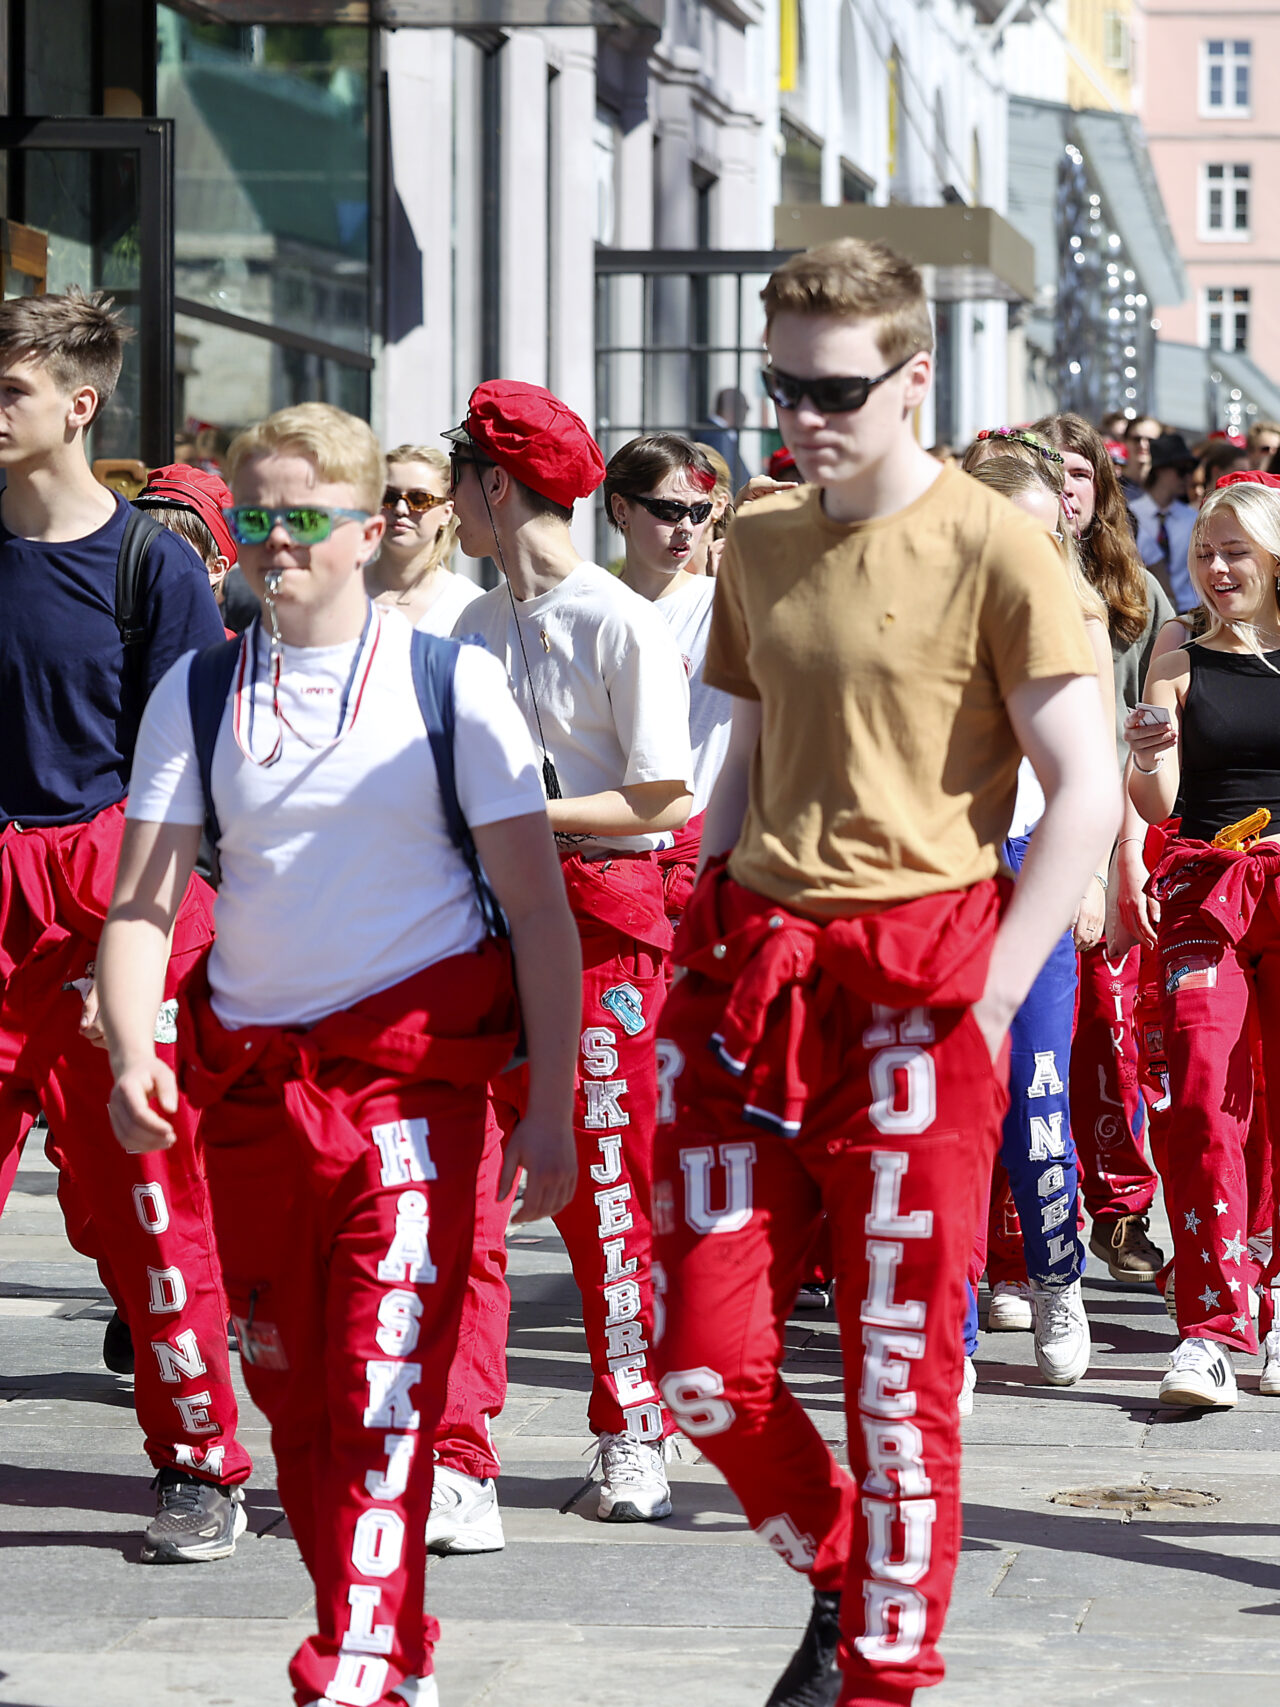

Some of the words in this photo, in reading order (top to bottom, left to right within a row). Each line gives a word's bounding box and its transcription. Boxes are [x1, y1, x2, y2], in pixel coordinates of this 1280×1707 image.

[126, 1148, 226, 1478] ODNEM
[580, 1026, 664, 1440] SKJELBRED
[1027, 1049, 1075, 1267] ANGEL
